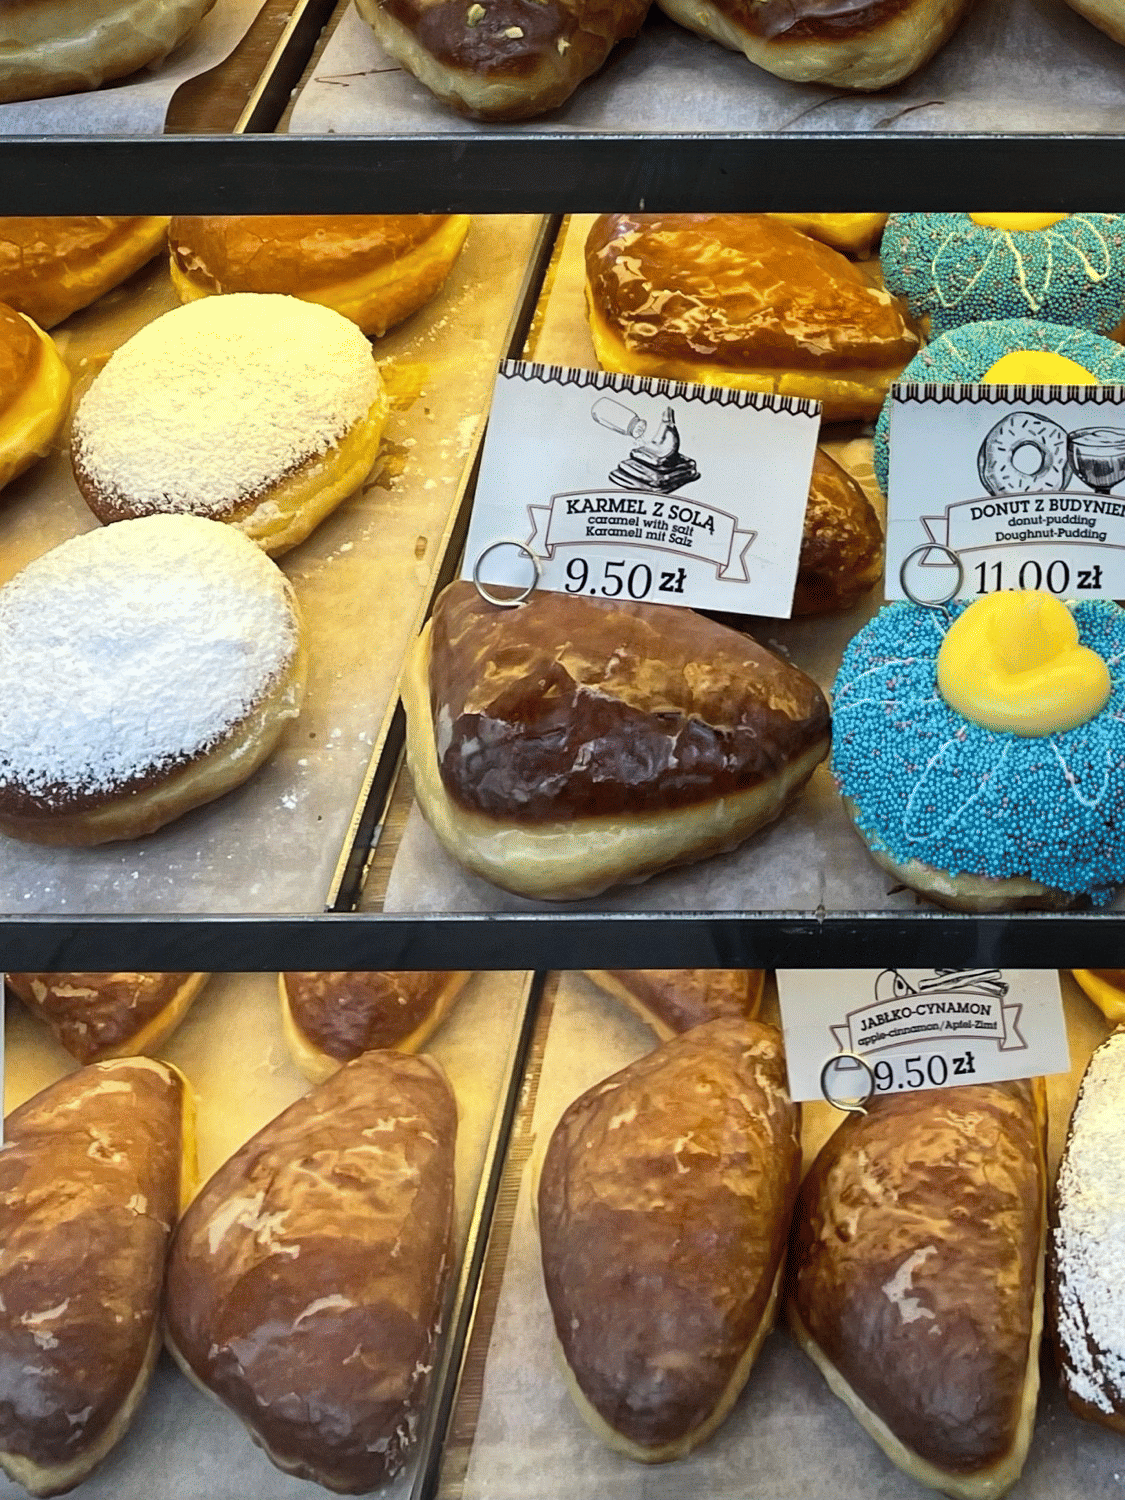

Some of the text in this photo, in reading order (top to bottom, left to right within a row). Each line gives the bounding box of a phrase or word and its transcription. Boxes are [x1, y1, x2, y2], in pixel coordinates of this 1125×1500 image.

[566, 498, 715, 535] KARMEL Z SOLĄ
[971, 501, 1030, 520] DONUT
[1035, 499, 1044, 512] Z
[588, 515, 694, 536] caramel with salt
[1008, 515, 1096, 527] donut-pudding
[586, 526, 693, 547] Karamell mit Salz
[995, 527, 1107, 542] Doughnut-Pudding
[565, 557, 687, 599] 9.50 zł
[1077, 565, 1103, 589] zł
[860, 1003, 992, 1031] JABŁKO-CYNAMON
[875, 1051, 976, 1091] 9.50 zł
